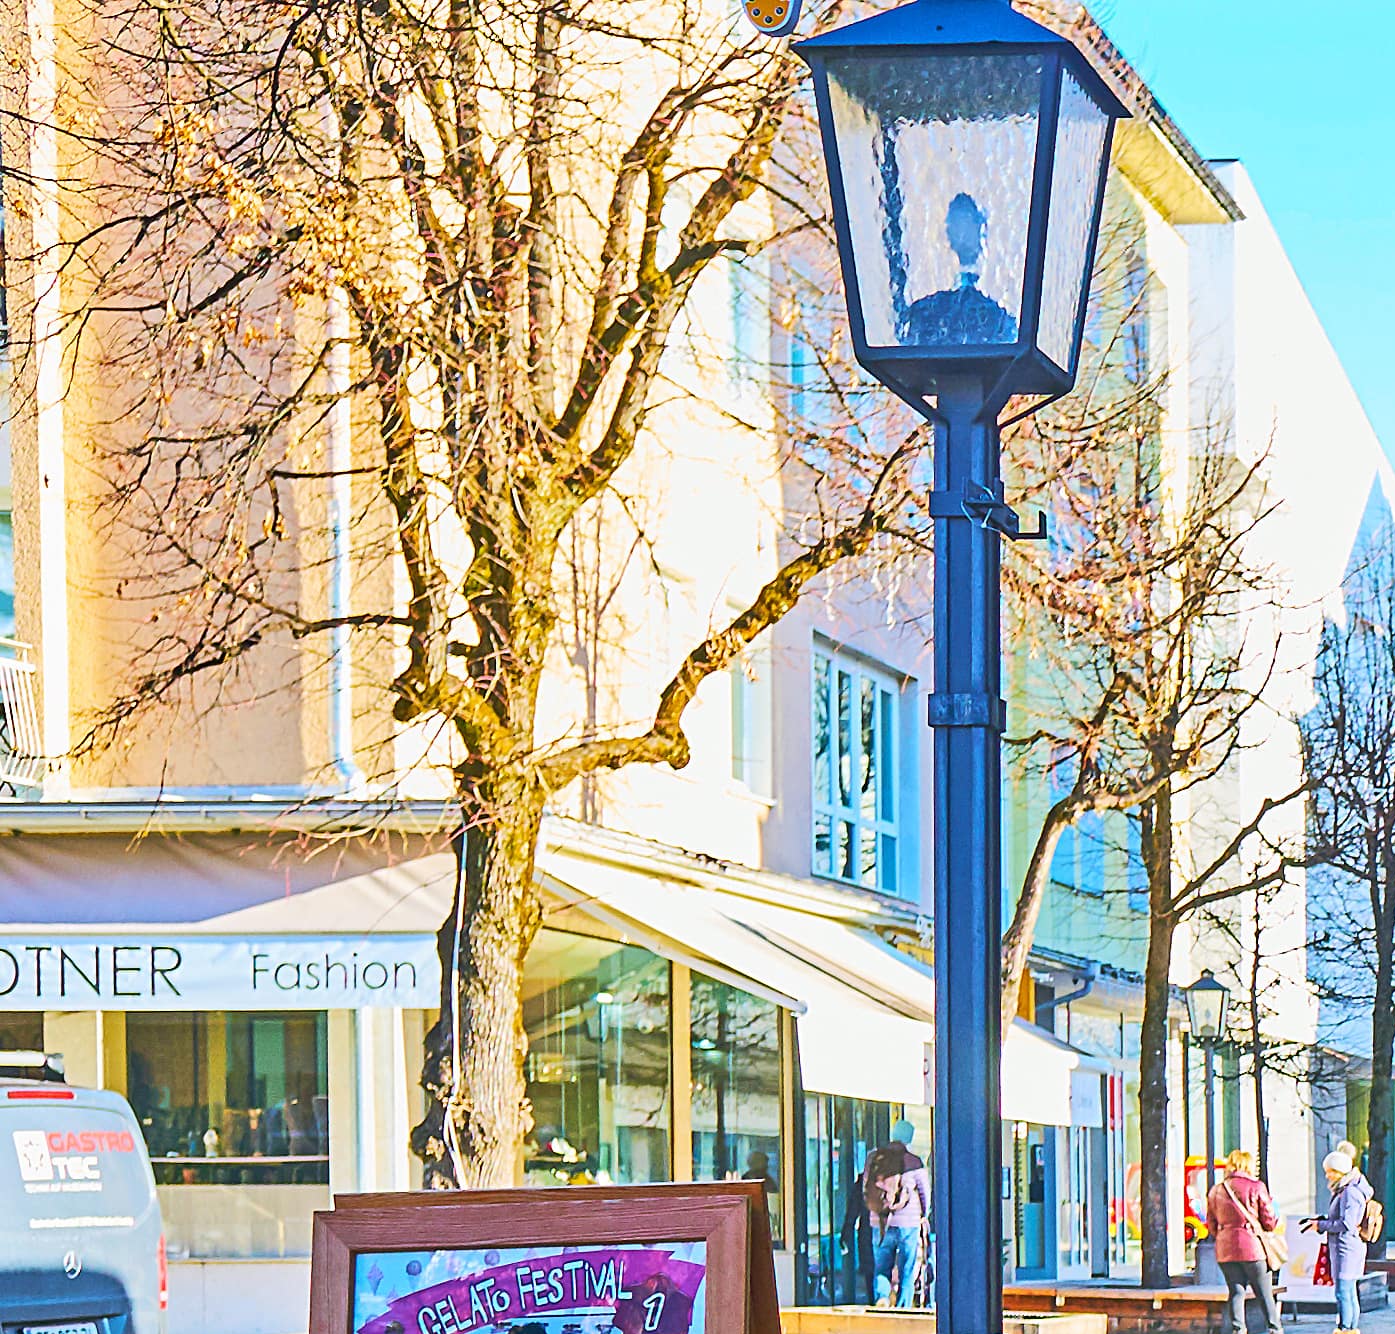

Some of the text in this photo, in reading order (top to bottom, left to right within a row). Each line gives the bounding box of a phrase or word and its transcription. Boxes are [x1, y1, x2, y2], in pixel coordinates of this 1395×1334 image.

[252, 952, 417, 990] Fashion
[47, 1131, 134, 1153] GASTRO
[52, 1156, 101, 1180] TEC
[642, 1292, 666, 1332] 1
